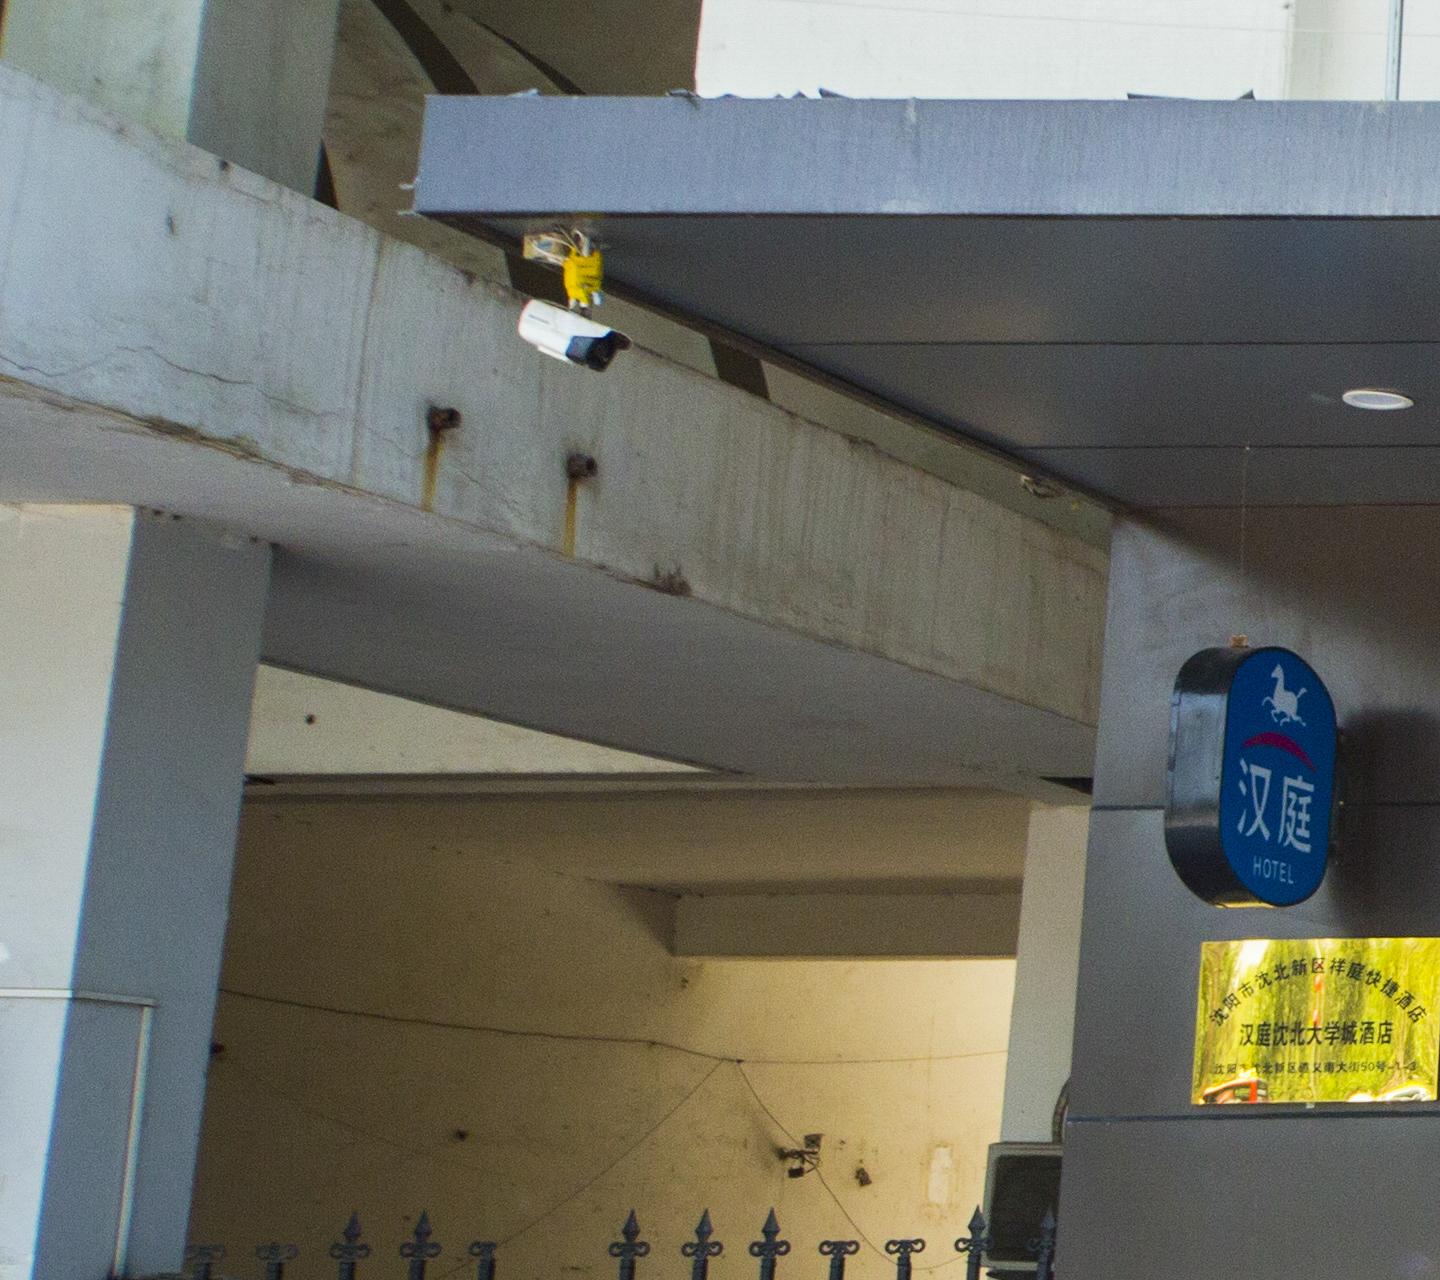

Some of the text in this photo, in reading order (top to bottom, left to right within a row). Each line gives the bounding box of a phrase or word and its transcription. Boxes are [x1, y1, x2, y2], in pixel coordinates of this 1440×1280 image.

[1237, 758, 1316, 855] 汉庭
[1253, 854, 1295, 886] HOTEL
[1208, 956, 1428, 1026] 沈阳市沈北新区祥庭快捷酒店
[1238, 1020, 1394, 1047] 汉庭沈北大学城酒店
